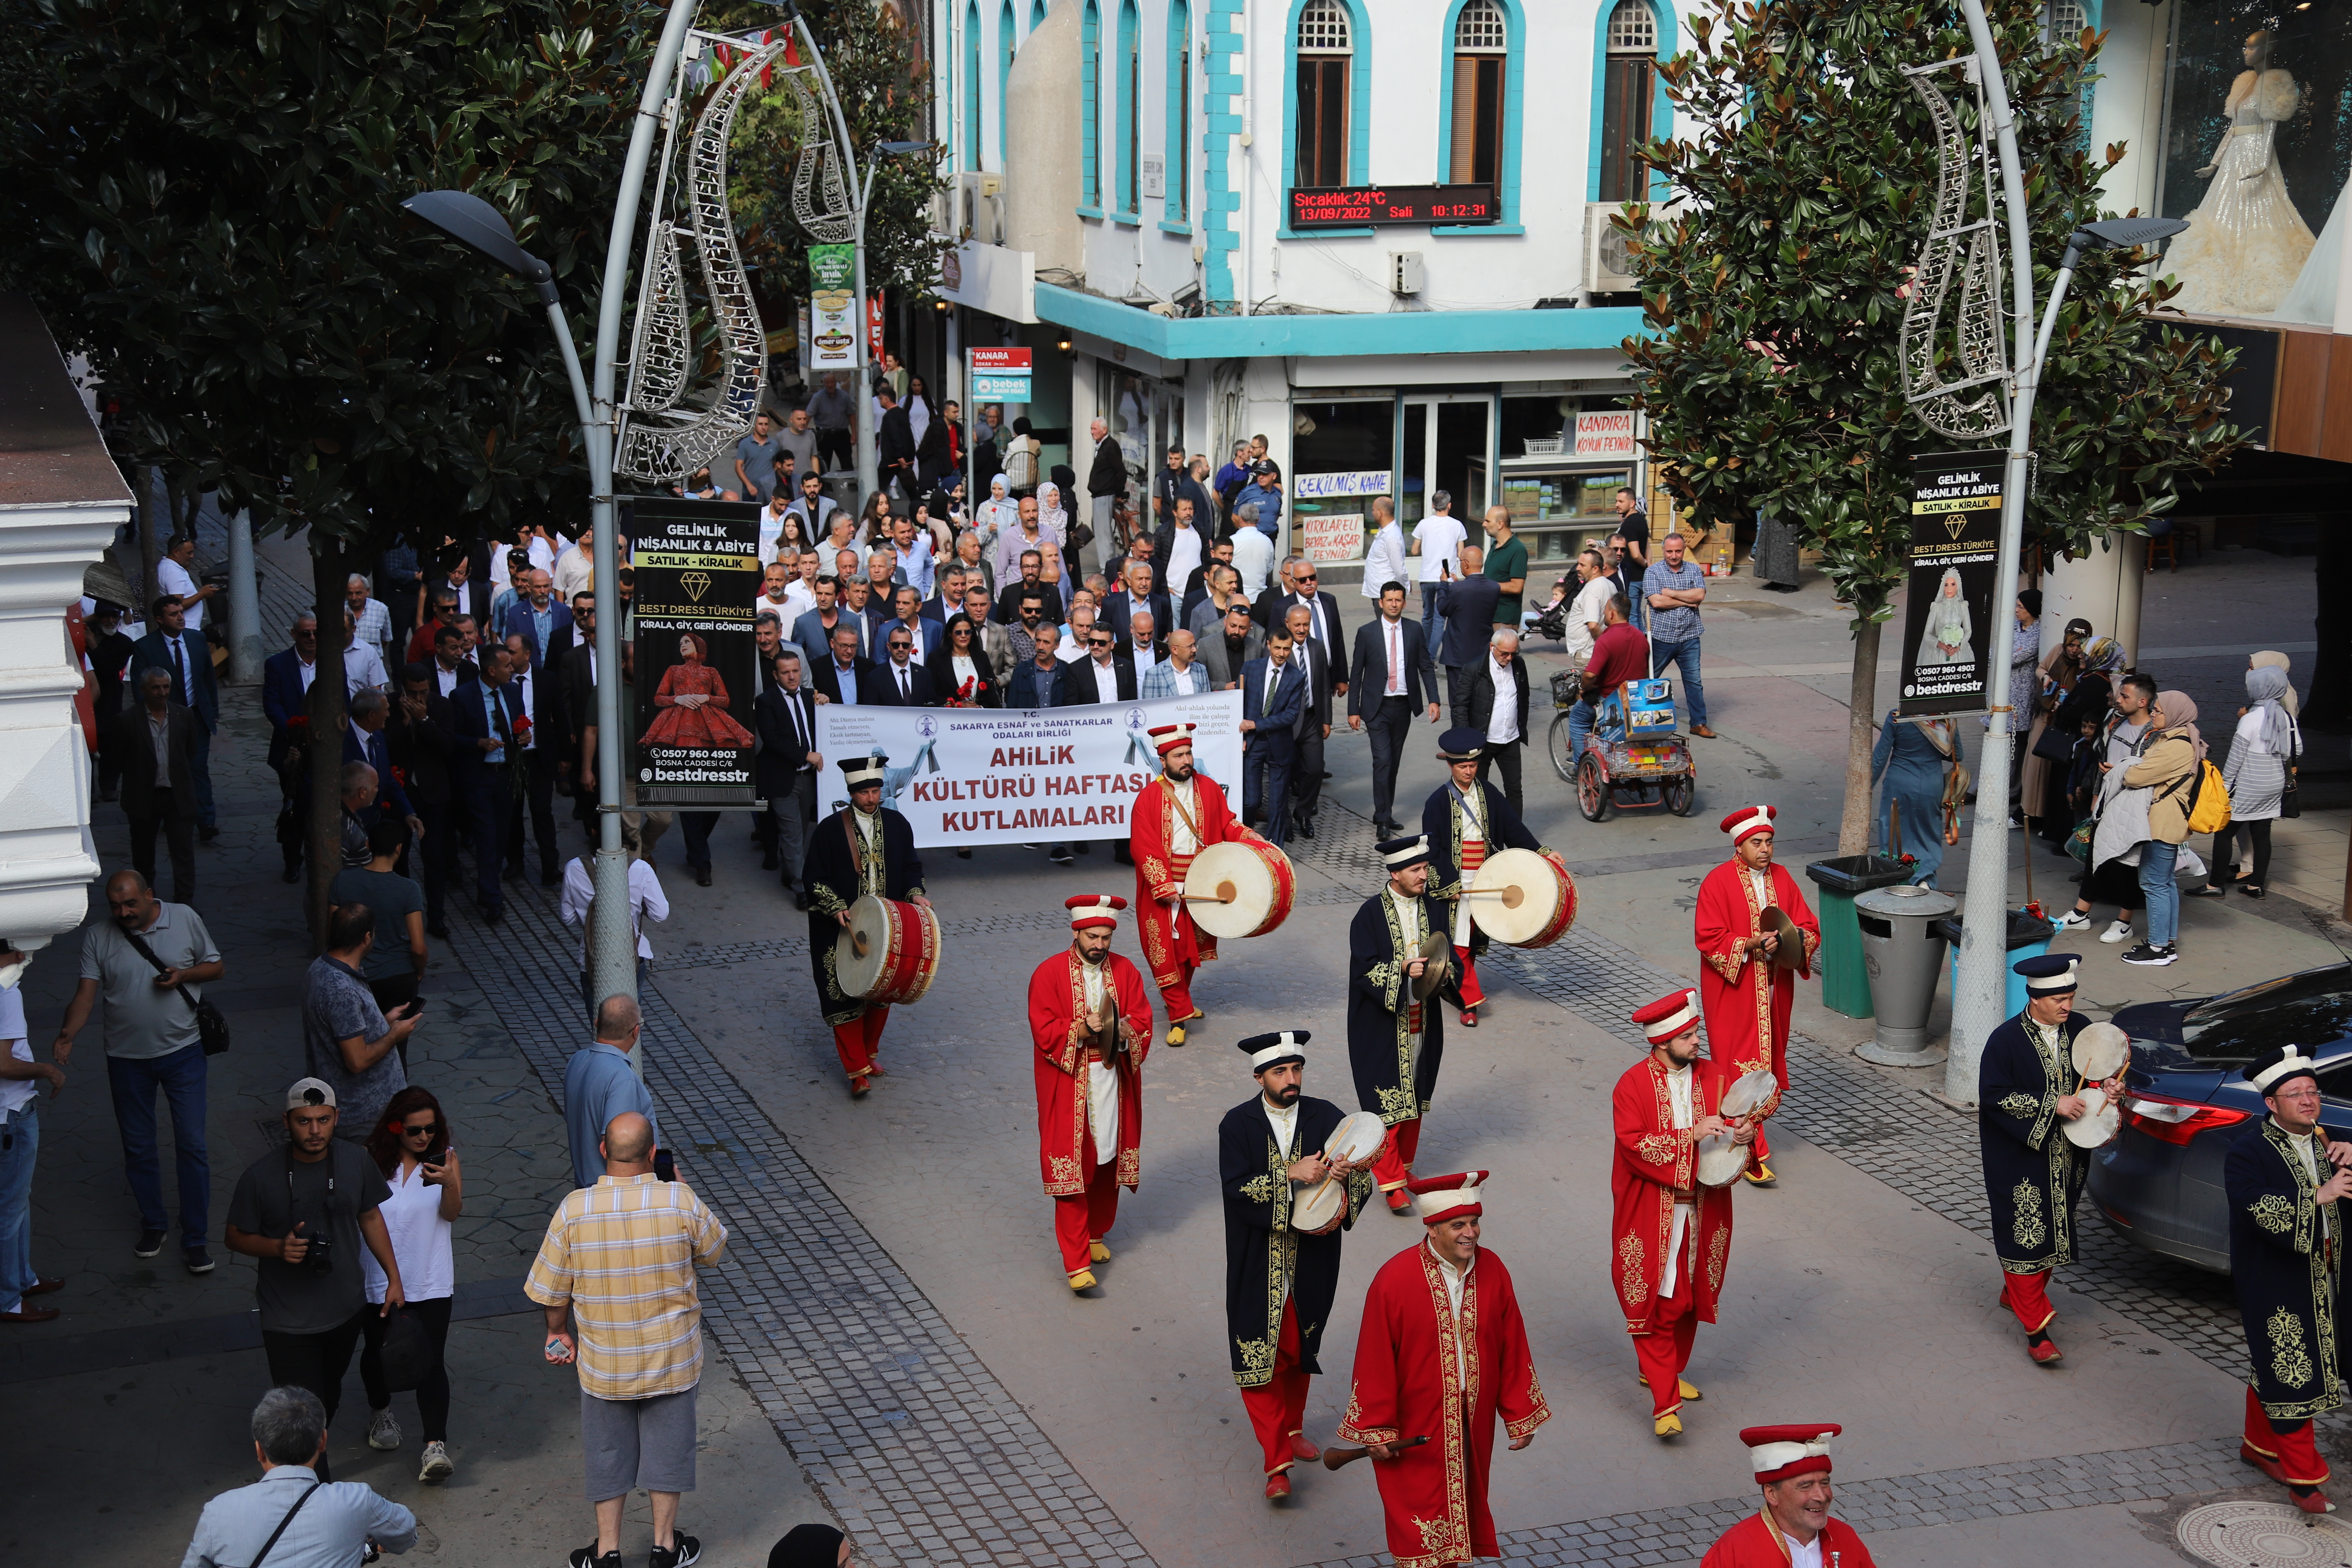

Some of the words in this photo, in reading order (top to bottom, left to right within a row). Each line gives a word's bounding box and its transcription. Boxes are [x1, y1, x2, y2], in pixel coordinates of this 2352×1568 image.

[1300, 207, 1370, 220] 13/09/2022
[992, 379, 1026, 387] bebek
[1578, 415, 1630, 432] KANDIRA
[1577, 436, 1603, 454] KOYUN
[1603, 434, 1635, 451] PEYNİRİ
[1298, 473, 1357, 497] ÇEKİLMİŞ
[1360, 473, 1387, 493] KAHVE
[1938, 471, 1980, 485] GELİNLİK
[1917, 487, 1961, 500] NİŞANLIK
[1962, 487, 1969, 496] &
[1971, 483, 1999, 495] ABİYE
[1923, 502, 1952, 512] SATILIK
[1959, 499, 1990, 509] KİRALIK
[667, 523, 727, 537] GELİNLİK
[1305, 516, 1359, 534] KIRKLARELİ
[638, 536, 701, 551] NİŞANLIK
[703, 540, 712, 551] &
[715, 539, 755, 553] ABİYE
[1305, 536, 1329, 548] BEYAZ
[1333, 533, 1360, 548] KAŞAR
[1914, 545, 1934, 553] BEST
[1936, 543, 1961, 552] DRESS
[1963, 539, 1995, 550] TÜRKİYE
[1313, 548, 1351, 560] PEYNİRİ
[1914, 558, 1939, 567] KİRALA,
[1939, 557, 1951, 565] GİY,
[1952, 555, 1967, 564] GERİ
[1967, 554, 1994, 562] GÖNDER
[648, 556, 690, 566] SATILIK
[699, 556, 743, 568] KİRALIK
[639, 604, 666, 613] BEST
[670, 605, 705, 614] DRESS
[707, 605, 753, 616] TÜRKİYE
[640, 619, 675, 630] KİRALA,
[676, 620, 692, 631] GİY,
[694, 621, 714, 630] GERİ
[715, 622, 753, 632] GÖNDER
[1916, 680, 1983, 695] bestdresstr
[1044, 718, 1113, 727] SANATKARLAR
[1037, 728, 1071, 737] BİRLİĞİ
[662, 749, 687, 758] 0507
[655, 768, 749, 782] bestdresstr
[914, 773, 1035, 802] KÜLTÜRÜ
[943, 805, 1124, 832] KUTLAMALARI
